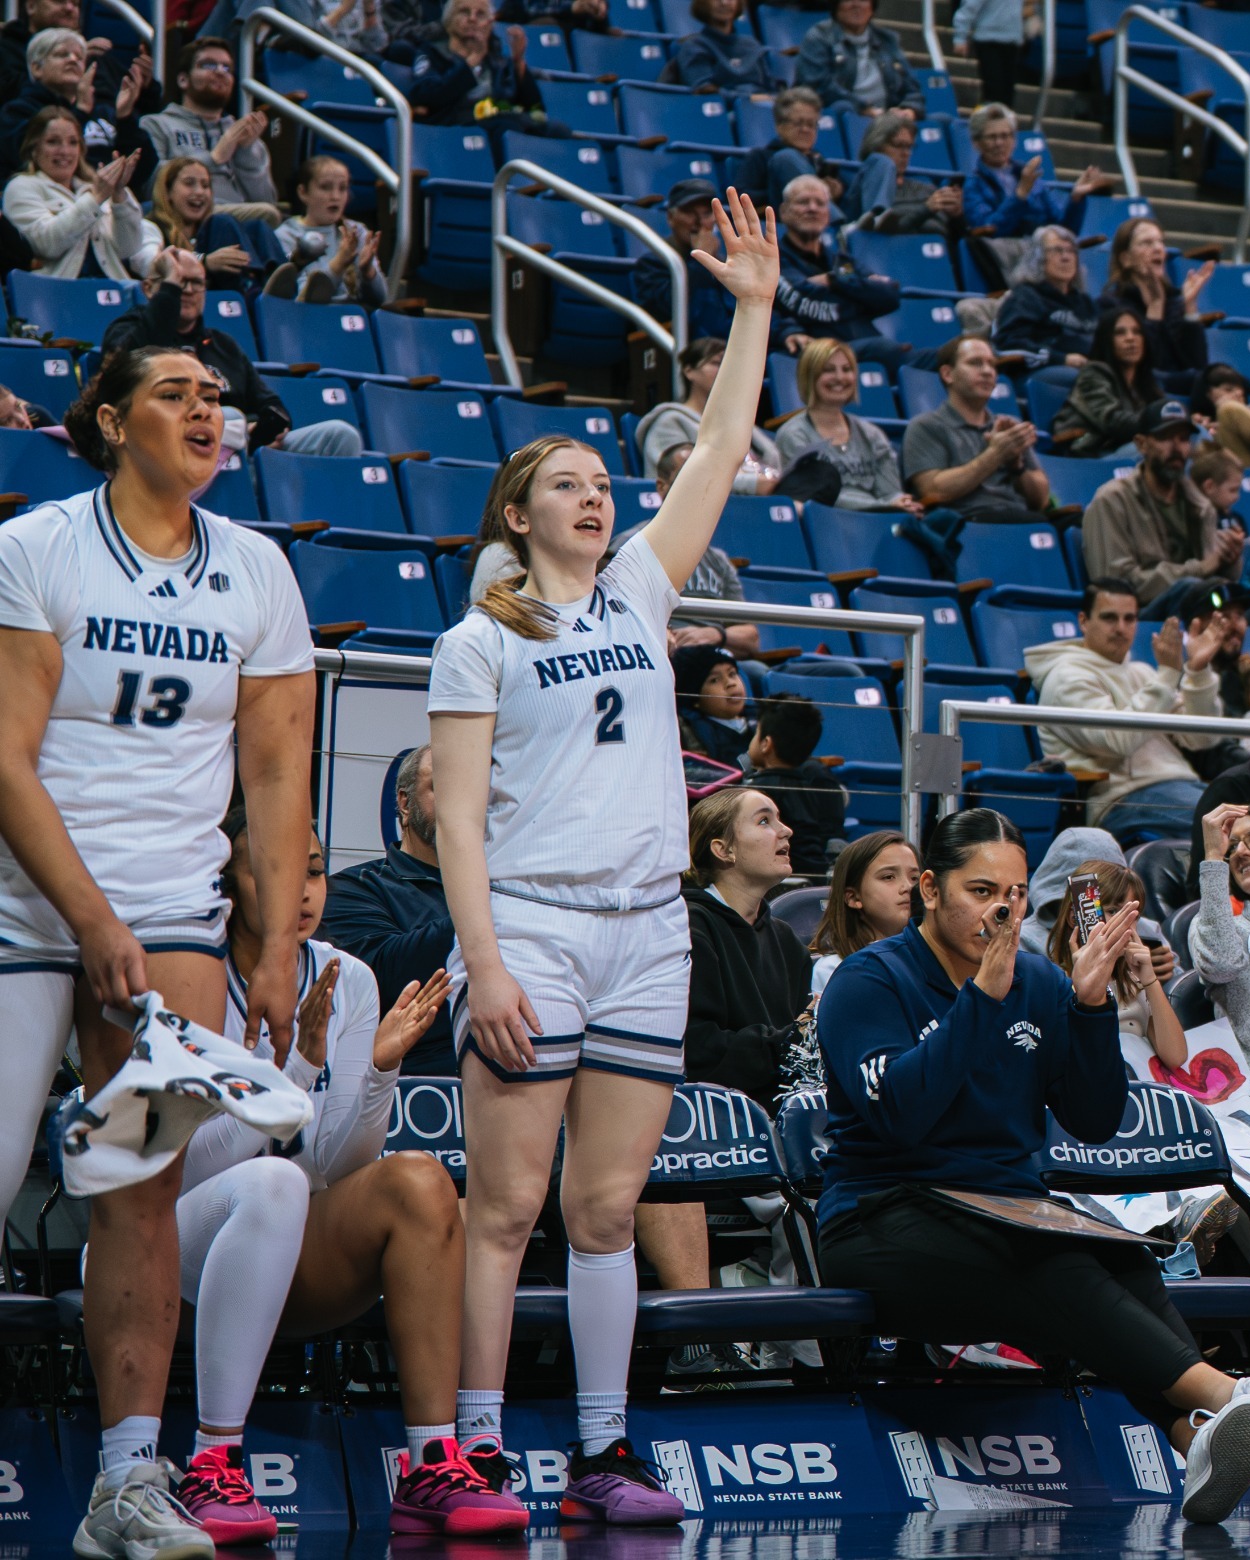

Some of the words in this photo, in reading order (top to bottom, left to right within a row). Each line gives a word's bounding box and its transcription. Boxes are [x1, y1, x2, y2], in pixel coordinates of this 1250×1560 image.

[83, 617, 229, 663] NEVADA
[532, 643, 655, 689] NEVADA
[110, 668, 193, 728] 13
[594, 685, 627, 746] 2
[1006, 1020, 1042, 1039] NEVDA
[386, 1085, 463, 1140] JOI
[662, 1090, 754, 1143] OINT
[650, 1144, 769, 1174] opractic
[1049, 1139, 1213, 1169] chiropractic
[701, 1442, 838, 1486] NSB
[935, 1435, 1061, 1476] NSB
[713, 1494, 764, 1503] NEVADA
[768, 1492, 805, 1501] STATE
[809, 1490, 843, 1500] BANK
[1000, 1483, 1034, 1492] STATE
[1037, 1482, 1069, 1491] BANK
